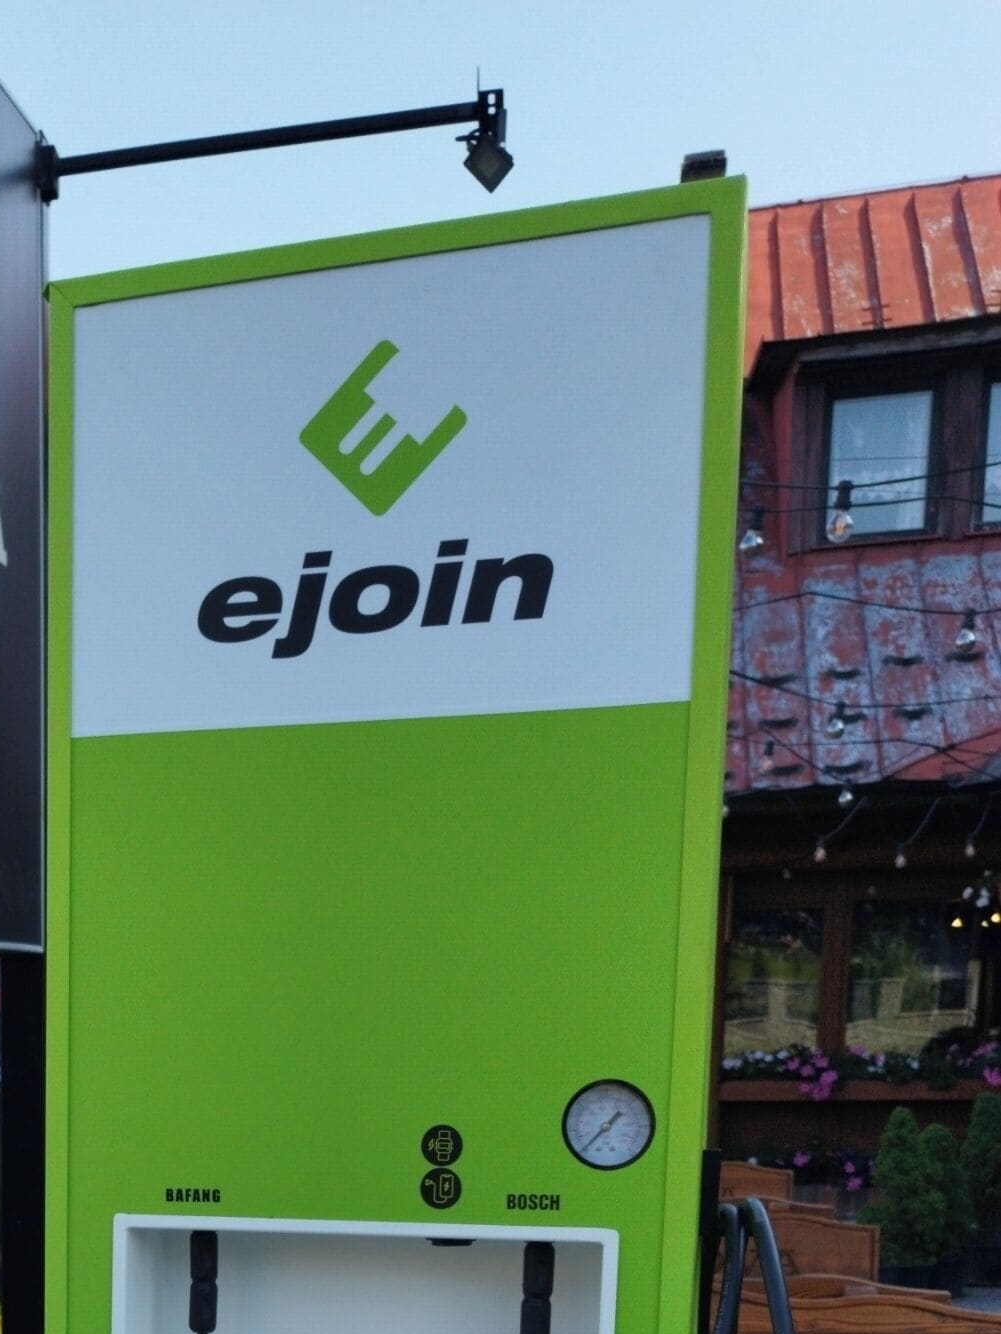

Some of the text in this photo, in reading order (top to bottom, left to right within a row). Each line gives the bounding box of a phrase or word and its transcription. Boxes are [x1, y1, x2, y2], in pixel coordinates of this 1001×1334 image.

[197, 538, 554, 659] ejoin
[165, 1188, 221, 1203] BAFANG
[506, 1193, 560, 1211] BOSCH
